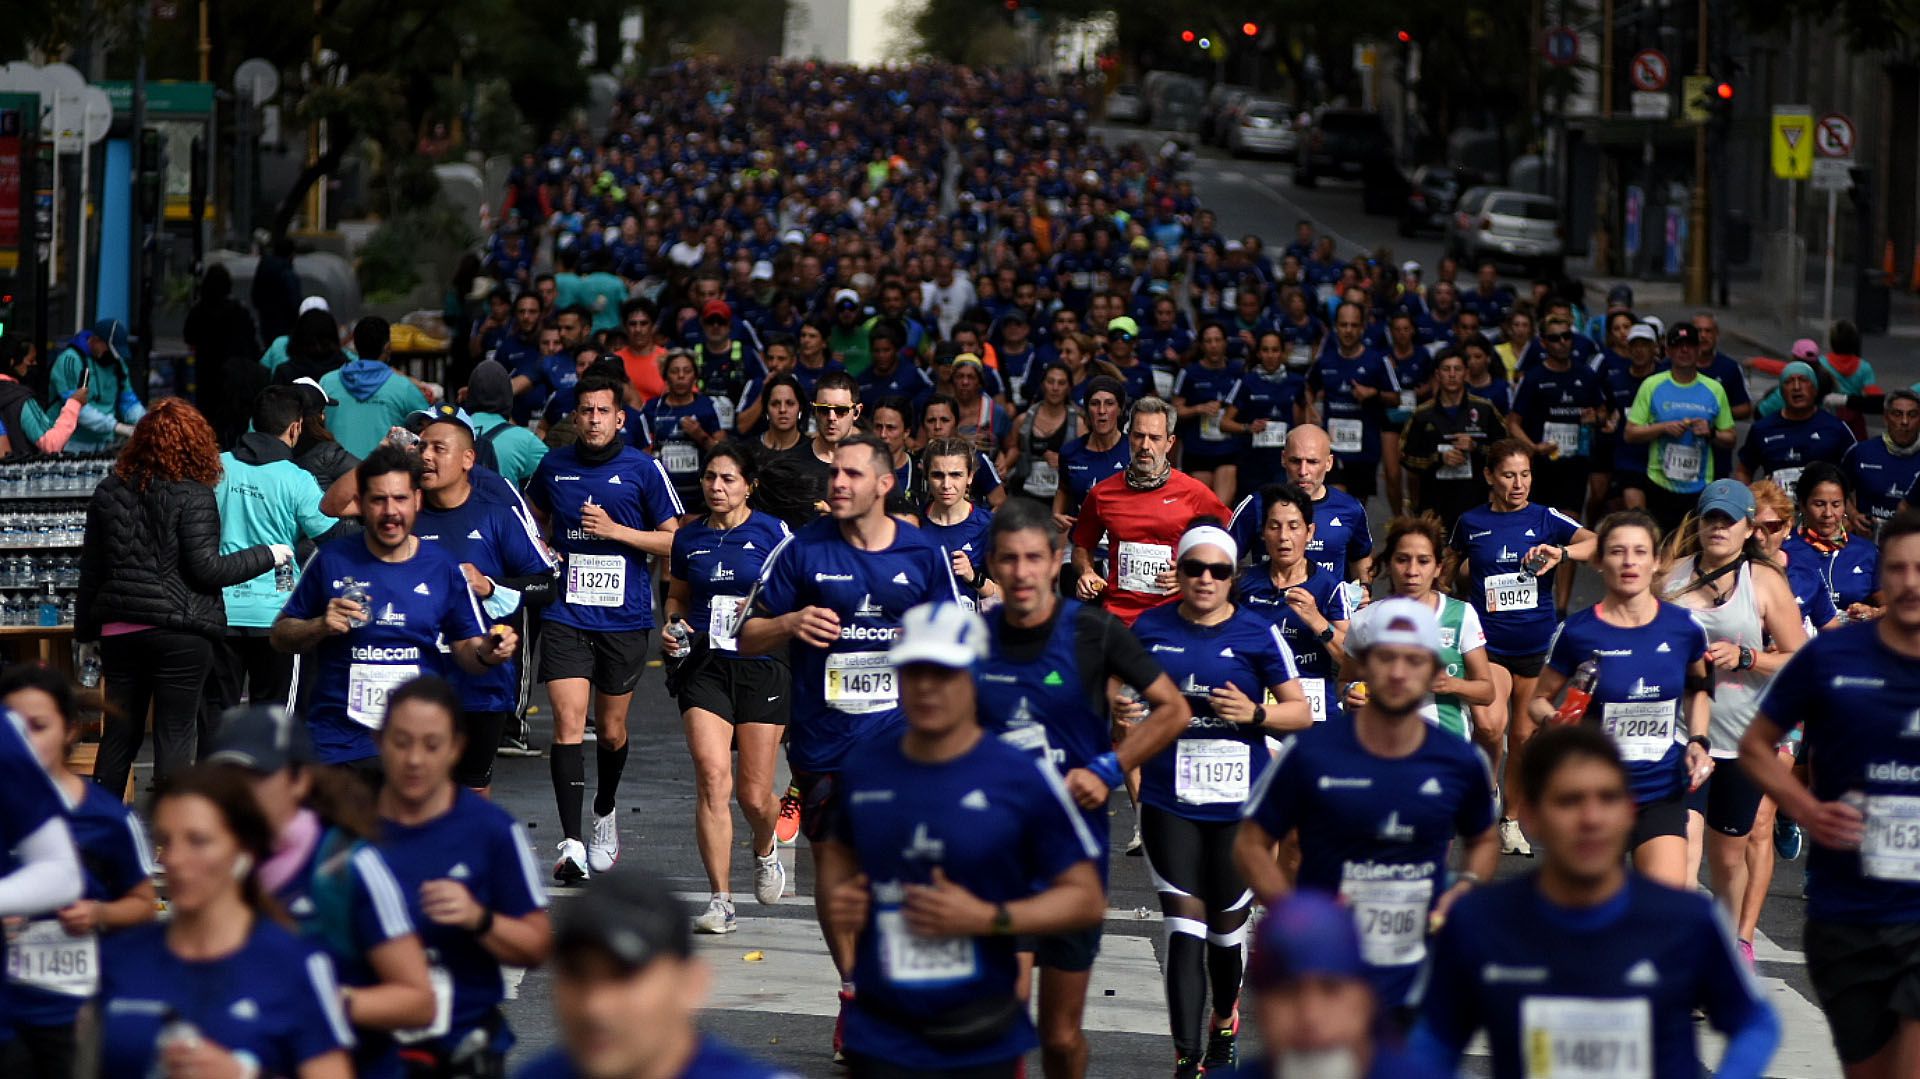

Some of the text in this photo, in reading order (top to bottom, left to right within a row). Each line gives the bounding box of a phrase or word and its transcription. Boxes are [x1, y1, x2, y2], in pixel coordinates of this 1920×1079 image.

[580, 572, 620, 589] 13276
[1500, 589, 1530, 605] 9942
[351, 645, 419, 661] telecom
[842, 672, 892, 693] 14673
[1615, 720, 1669, 737] 12024
[1194, 762, 1244, 783] 11973
[1365, 909, 1416, 935] 7906
[25, 949, 88, 977] 11496
